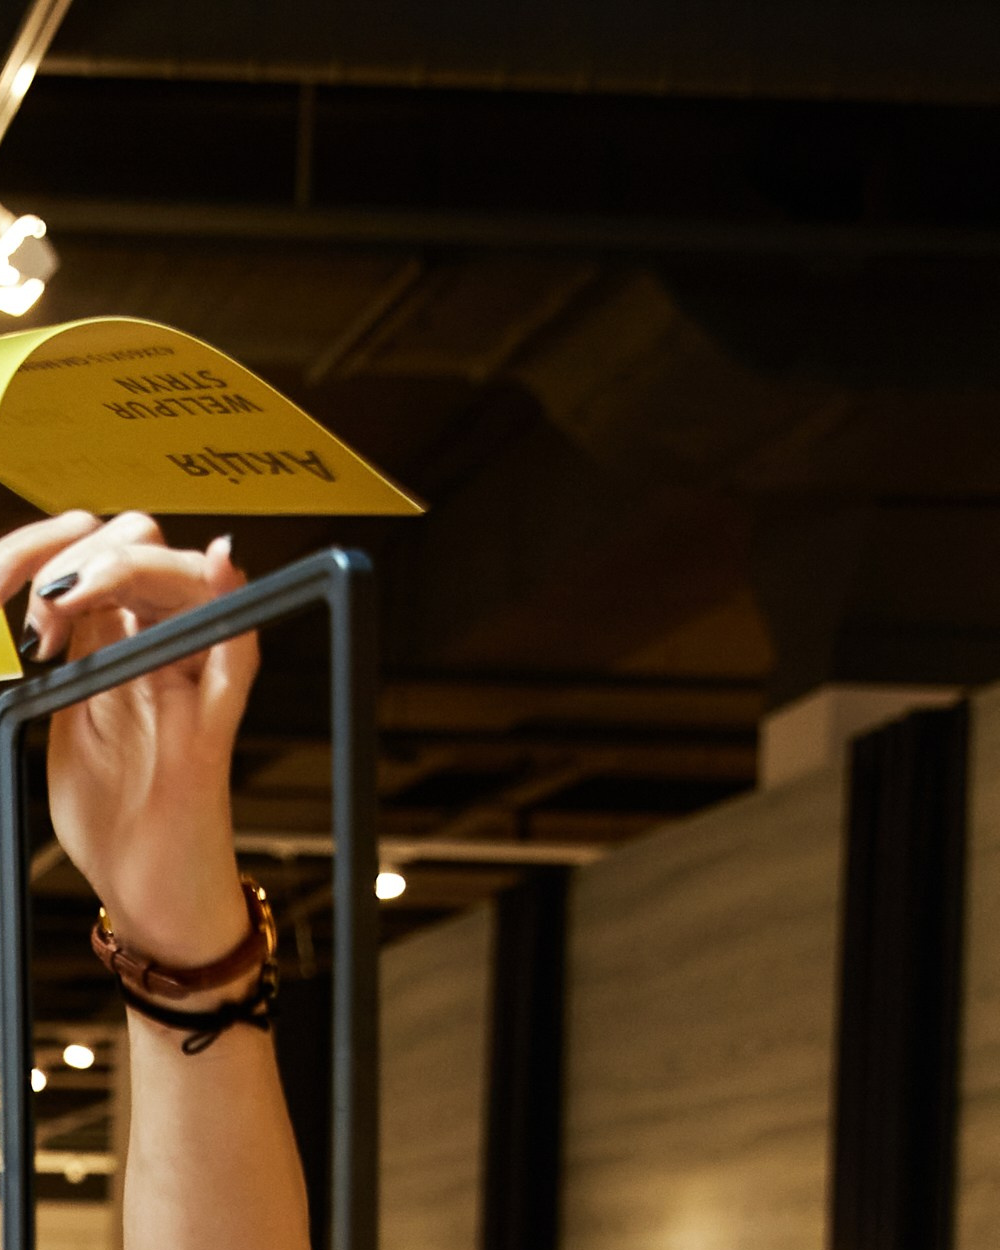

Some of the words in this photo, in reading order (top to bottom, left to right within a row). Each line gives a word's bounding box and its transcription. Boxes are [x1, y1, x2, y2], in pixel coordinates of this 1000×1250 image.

[114, 370, 228, 394] STRYN
[102, 393, 264, 420] WELLPUR
[165, 447, 337, 484] Акція
